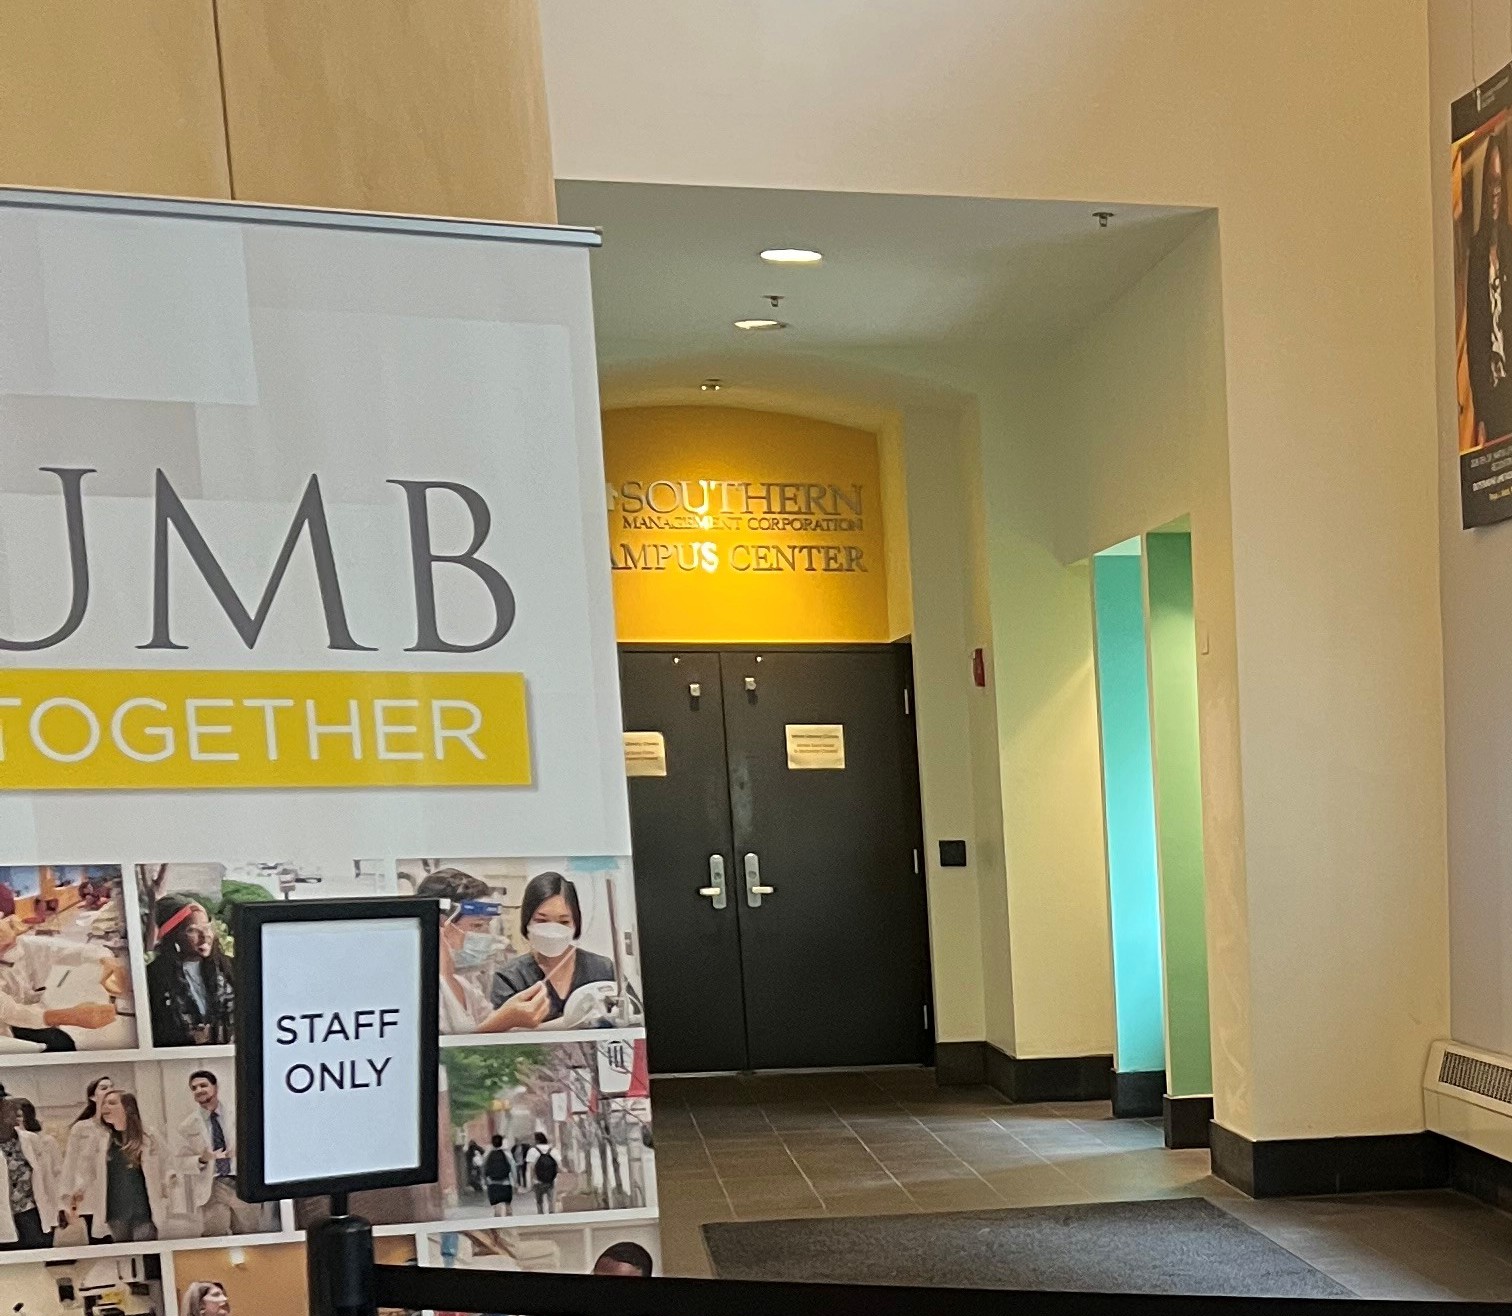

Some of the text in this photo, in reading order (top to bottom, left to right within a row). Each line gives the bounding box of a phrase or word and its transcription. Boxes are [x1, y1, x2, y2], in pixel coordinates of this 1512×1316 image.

[621, 480, 863, 516] SOUTHERN
[623, 515, 863, 532] MANAGEMENT CORPORATION
[728, 545, 868, 573] CENTER
[276, 1008, 400, 1046] STAFF
[285, 1056, 393, 1094] ONLY
